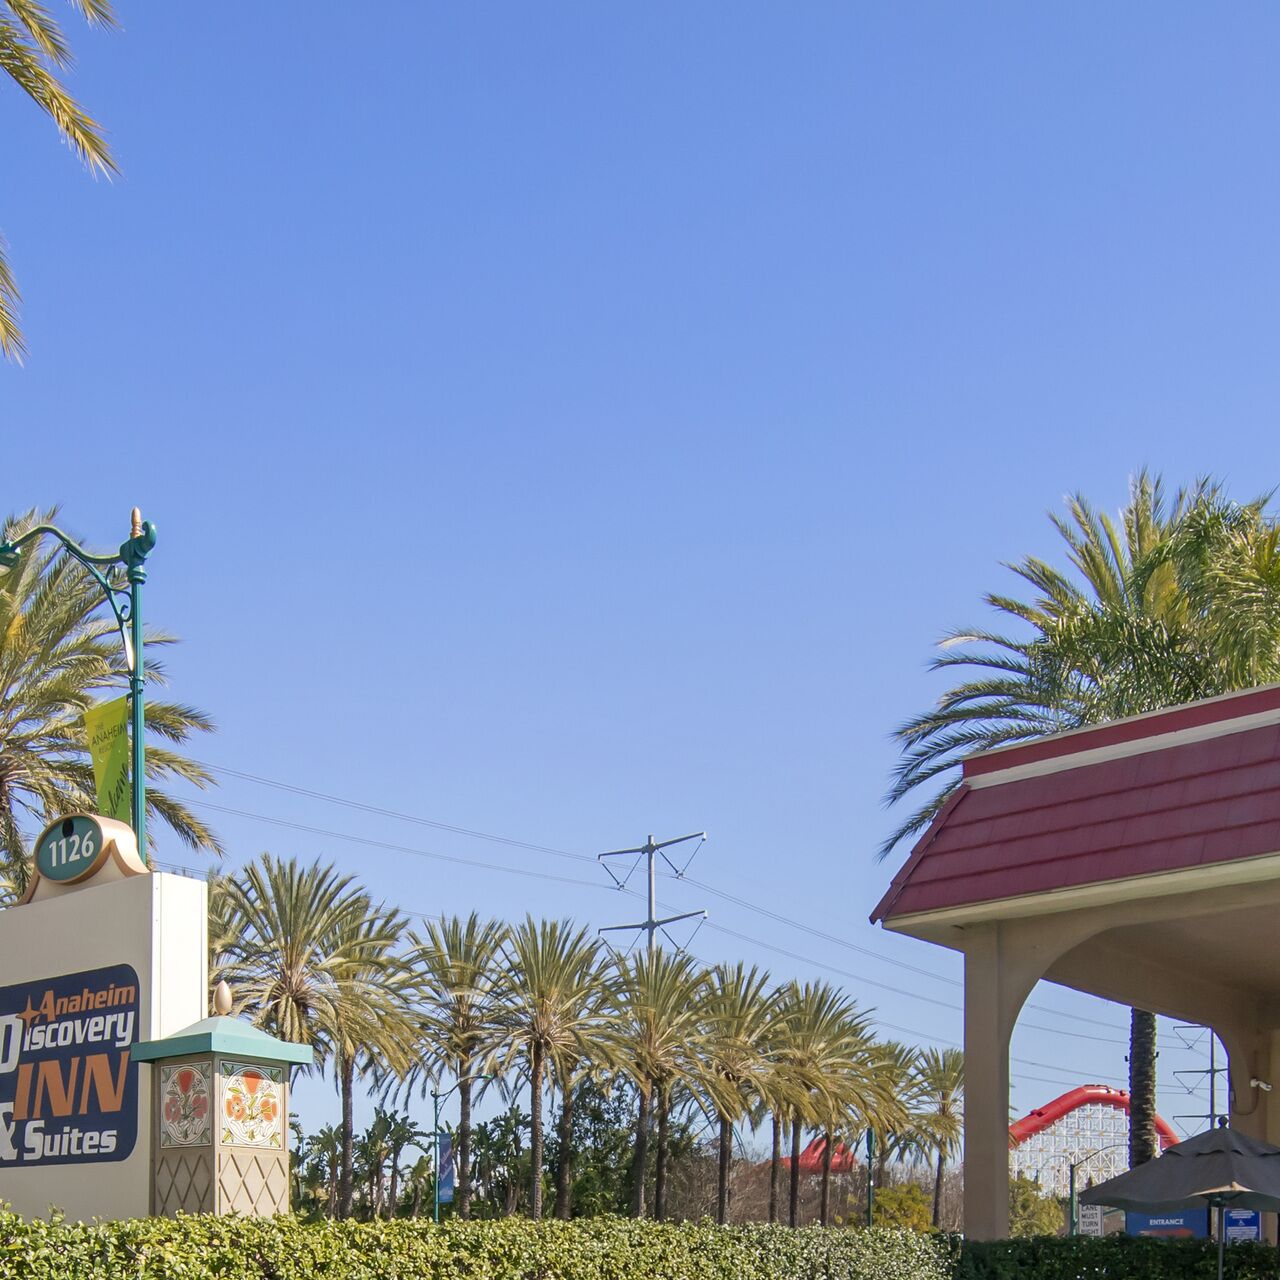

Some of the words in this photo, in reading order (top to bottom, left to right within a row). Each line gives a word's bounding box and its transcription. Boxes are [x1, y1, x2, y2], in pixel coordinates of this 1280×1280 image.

[49, 830, 94, 867] 1126
[34, 984, 136, 1024] Anaheim
[12, 1051, 131, 1121] INN
[23, 1120, 118, 1161] Suites
[1149, 1218, 1184, 1226] ENTRANCE
